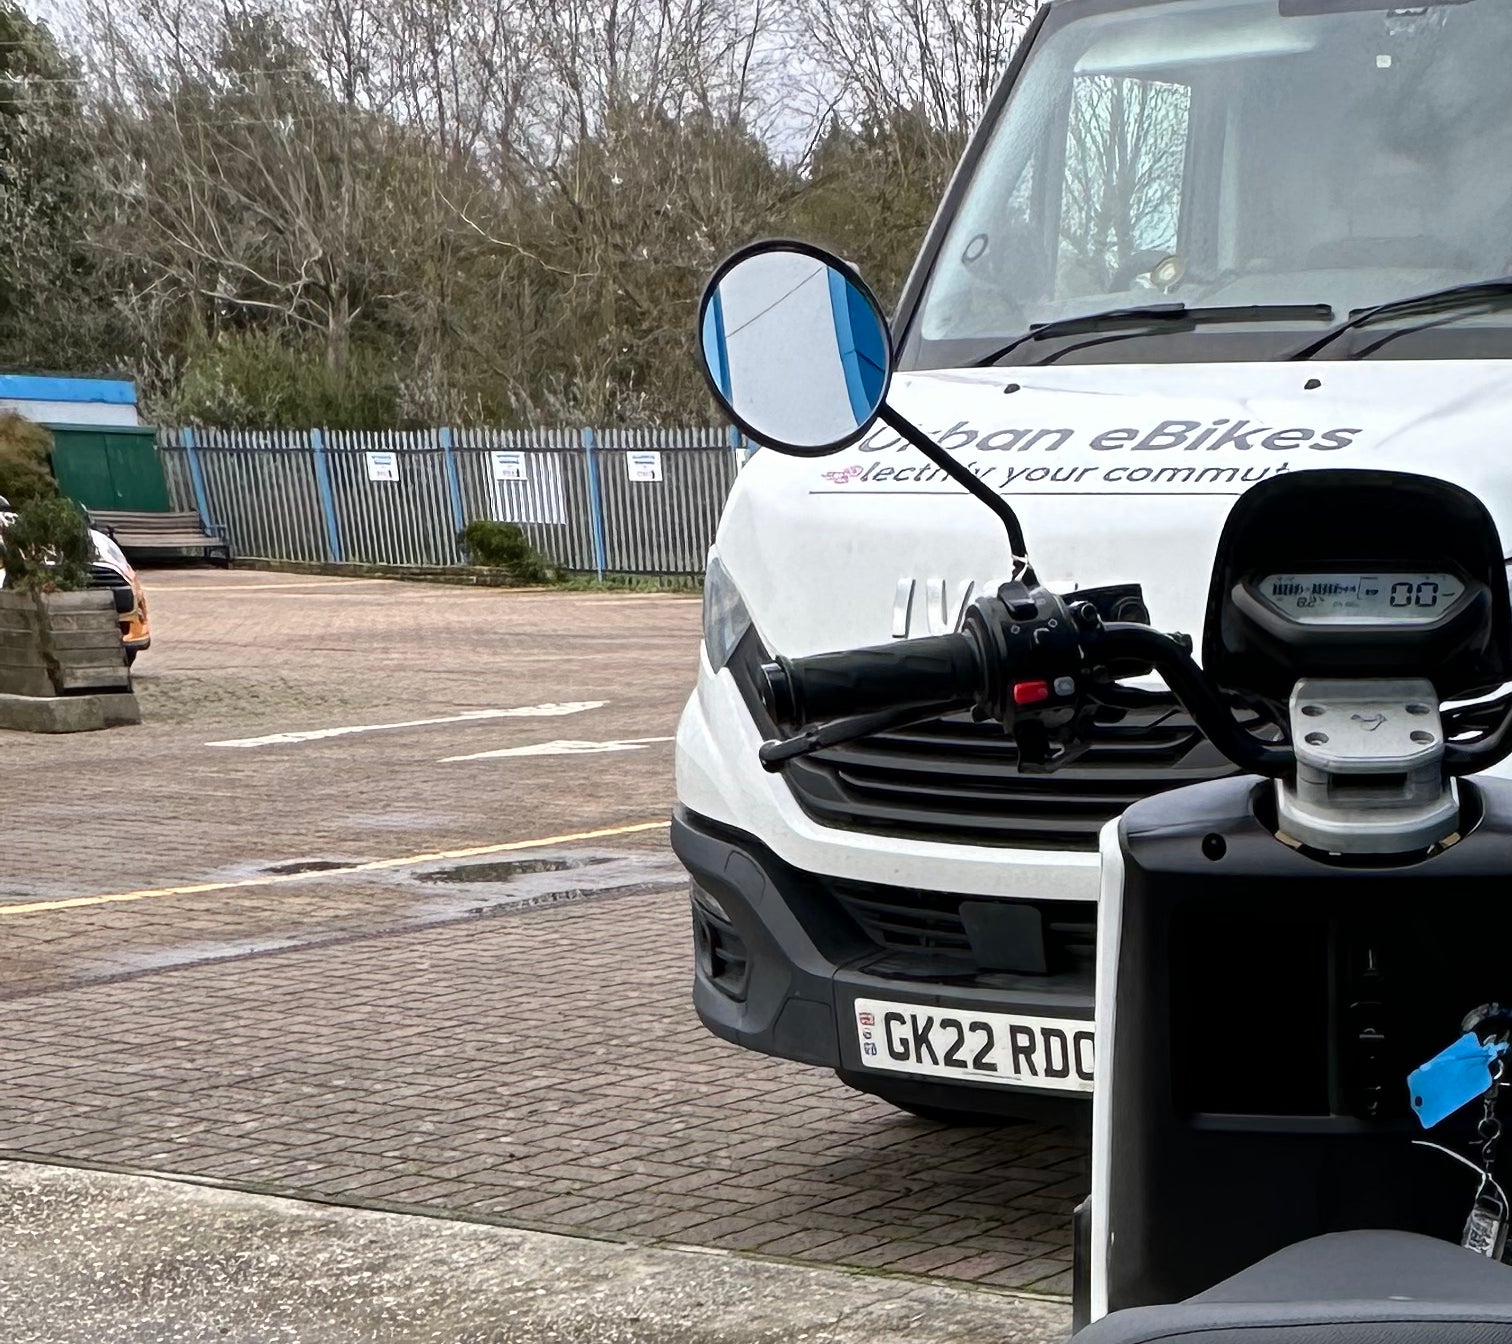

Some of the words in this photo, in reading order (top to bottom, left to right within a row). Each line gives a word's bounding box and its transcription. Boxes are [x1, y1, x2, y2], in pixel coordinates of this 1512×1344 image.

[858, 421, 1075, 452] Uban
[1088, 418, 1364, 452] eBikes
[999, 466, 1099, 489] your
[884, 1011, 998, 1072] GK22
[1009, 1023, 1096, 1081] RDO
